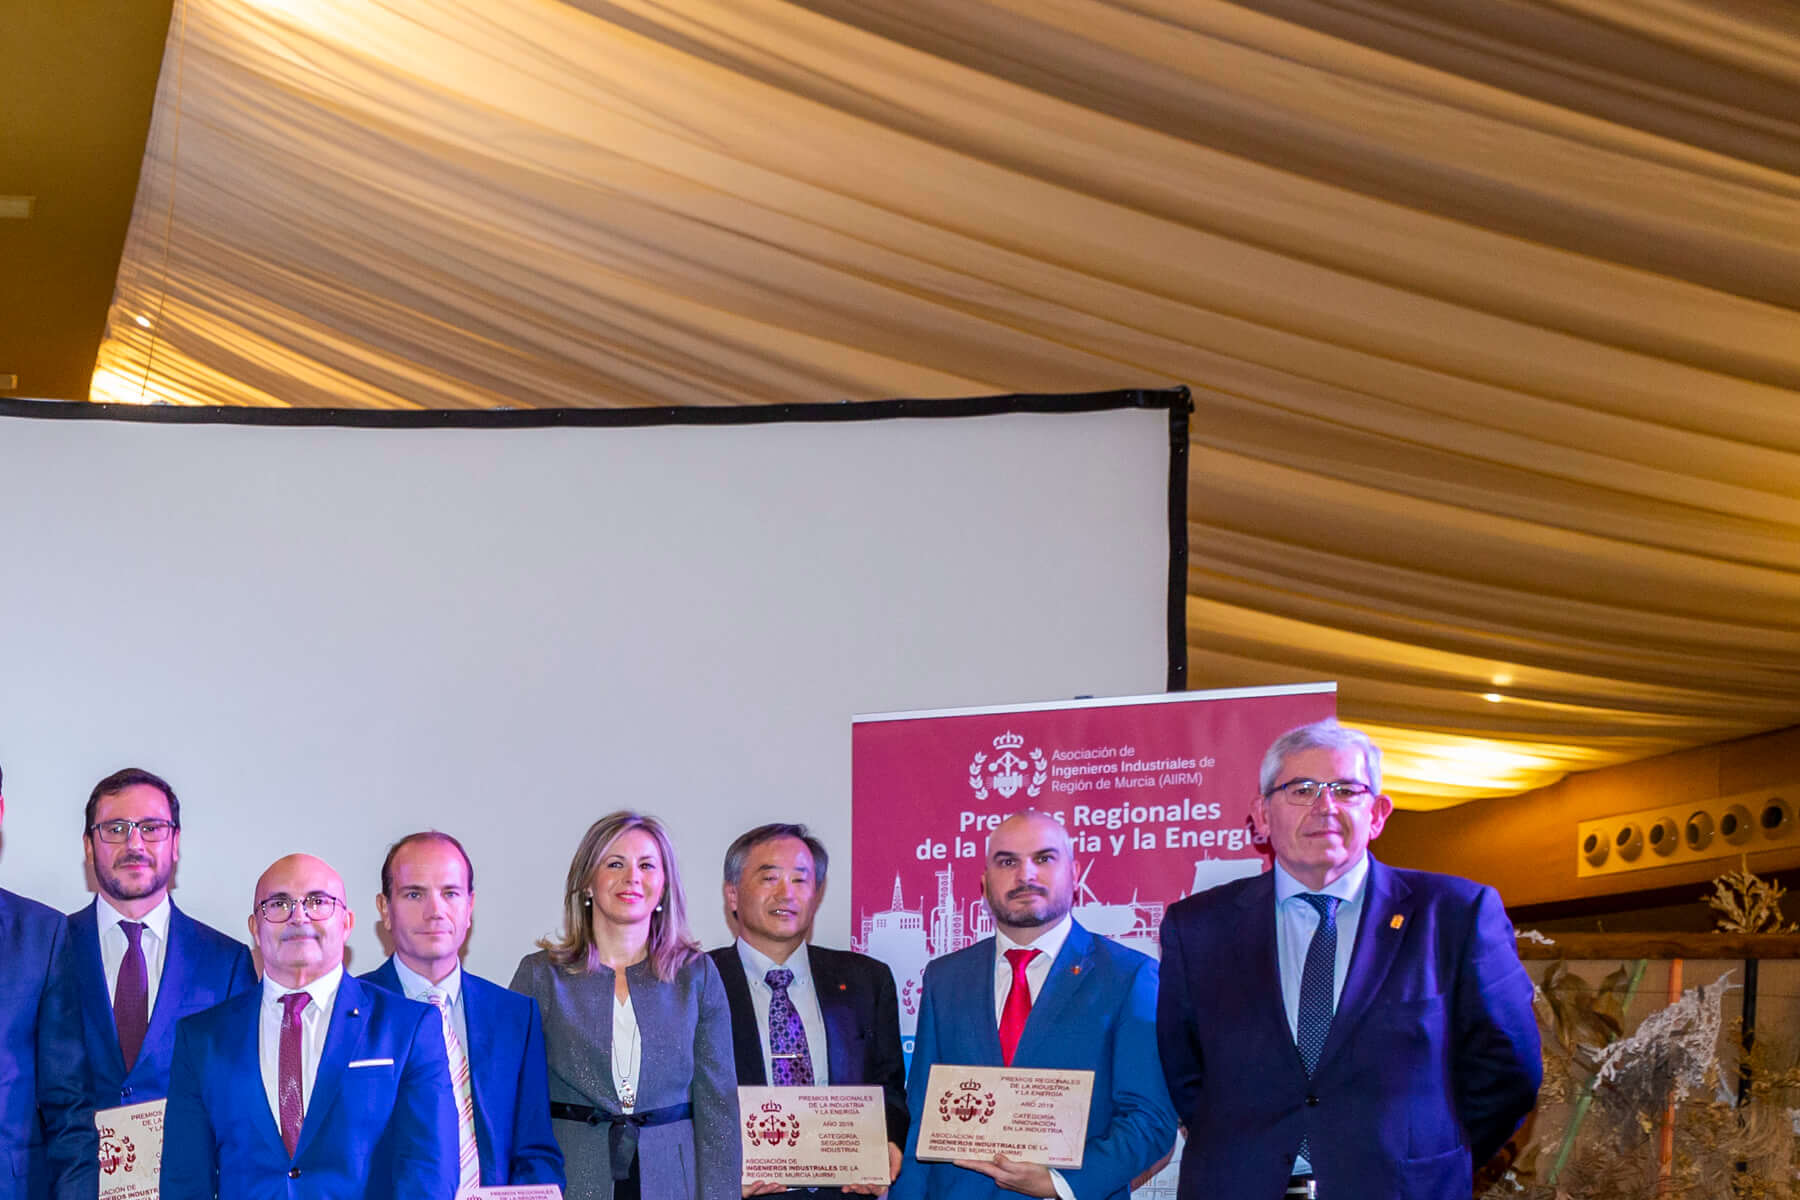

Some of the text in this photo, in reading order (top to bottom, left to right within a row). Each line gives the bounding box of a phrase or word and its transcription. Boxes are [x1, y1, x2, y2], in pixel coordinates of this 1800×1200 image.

[1052, 744, 1135, 761] Asociación de
[1051, 756, 1216, 779] Ingenieros Industriales de
[1051, 772, 1203, 795] Región de Murcia (AIIRM)
[960, 798, 1221, 832] Pres Regionales
[916, 838, 947, 860] de
[955, 836, 976, 858] la
[1109, 834, 1125, 857] y
[1133, 827, 1156, 850] la
[974, 1141, 1027, 1150] INDUSTRIALES
